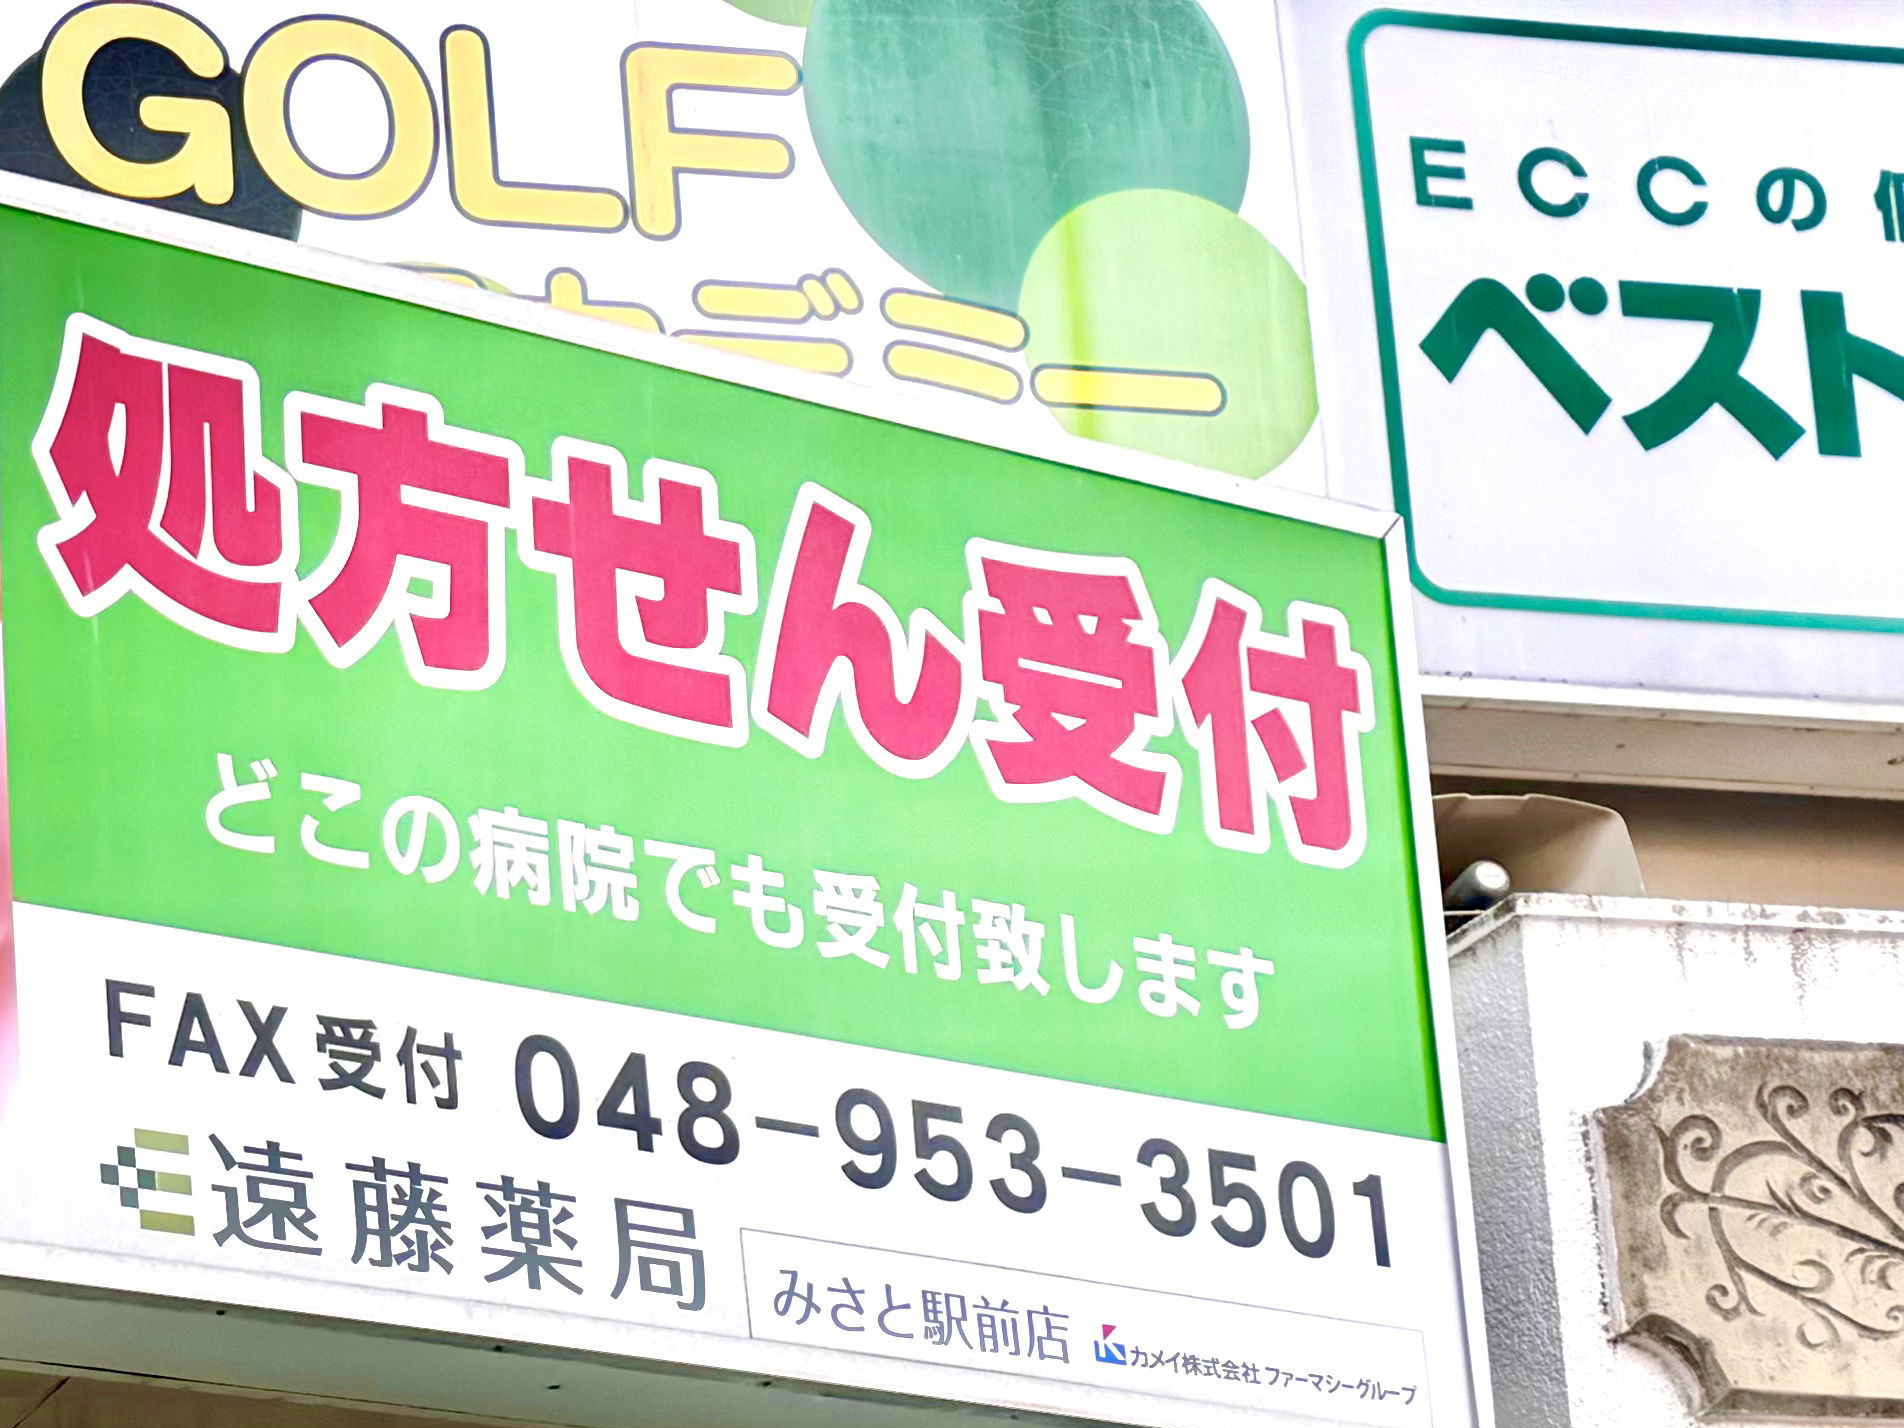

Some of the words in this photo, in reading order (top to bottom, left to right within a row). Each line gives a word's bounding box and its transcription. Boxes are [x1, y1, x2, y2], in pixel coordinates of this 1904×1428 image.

[41, 0, 801, 239] GOLF
[1419, 273, 1904, 462] ベスト
[33, 313, 1375, 866] 処方せん受付
[205, 753, 1276, 1029] どこの病院でも受付致します
[104, 979, 297, 1088] FAX
[313, 1015, 463, 1109] 受付
[516, 1032, 1390, 1268] 048-953-3501
[208, 1138, 706, 1312] 遠藤薬局
[773, 1264, 1070, 1365] みさと駅前店
[1130, 1343, 1260, 1386] カメイ株式会社
[1265, 1364, 1418, 1405] ファーマシーグループ
